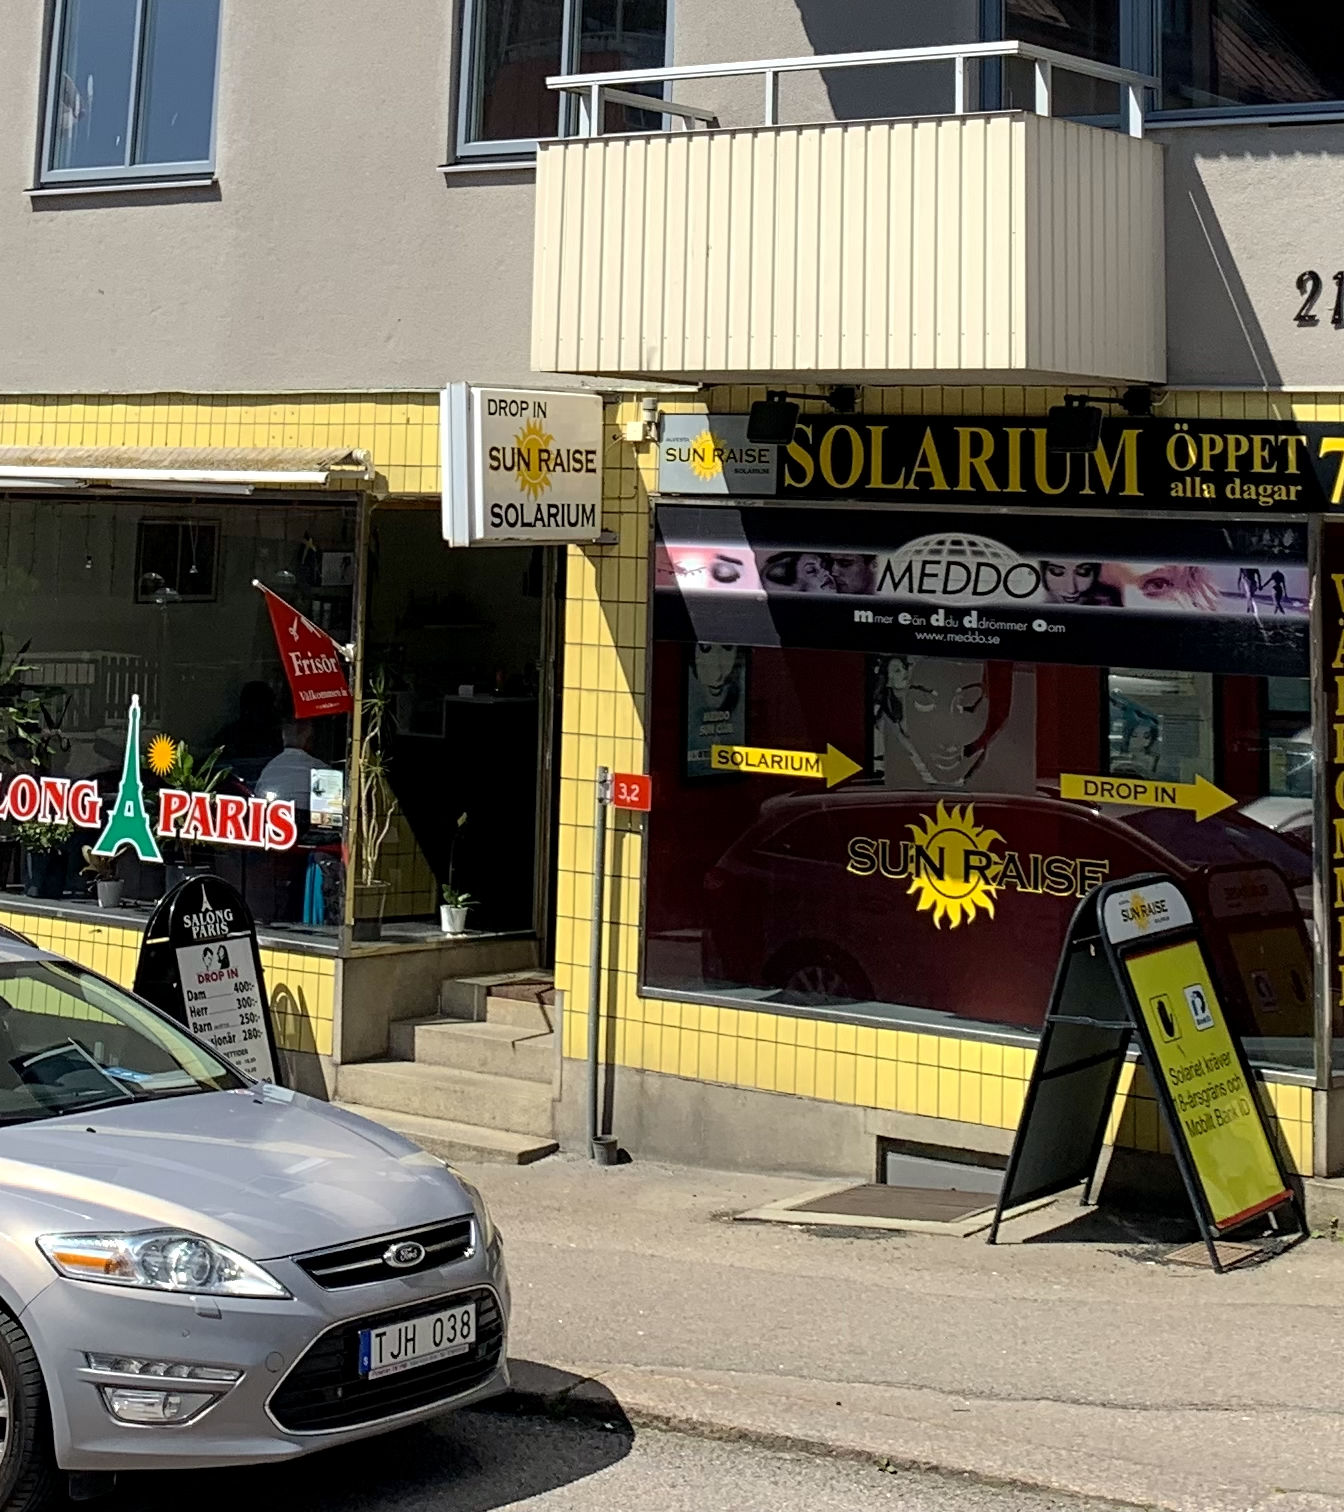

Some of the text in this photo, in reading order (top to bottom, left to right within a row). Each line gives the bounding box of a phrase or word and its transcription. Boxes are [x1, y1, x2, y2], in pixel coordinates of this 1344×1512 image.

[488, 398, 547, 419] DROP IN
[665, 447, 770, 464] SUN RAISE
[1166, 422, 1307, 474] ÖPPET
[489, 446, 597, 474] SUN RAISE
[784, 424, 1144, 496] SOLARIUM
[1170, 476, 1302, 506] alla dagar
[490, 502, 596, 528] SOLARIUM
[876, 558, 1041, 599] MEDDO
[915, 631, 1001, 644] www.meddo.se
[288, 651, 338, 676] Frisör
[717, 750, 820, 773] SOLARIUM
[1084, 780, 1177, 804] DROP IN
[158, 788, 299, 851] PARIS
[846, 836, 1110, 899] SUN RAISE
[183, 908, 233, 928] SALONG
[1121, 907, 1141, 922] SUN
[1140, 899, 1168, 918] RAISE
[192, 922, 229, 940] PARIS
[197, 969, 239, 984] DROP IN
[187, 990, 206, 1001] Dam
[189, 1007, 208, 1017] Herr
[192, 1022, 213, 1034] Barn
[1169, 1051, 1232, 1086] Solariet kräver
[1227, 1073, 1244, 1094] och
[375, 1323, 416, 1363] TJH
[433, 1310, 471, 1348] 038
